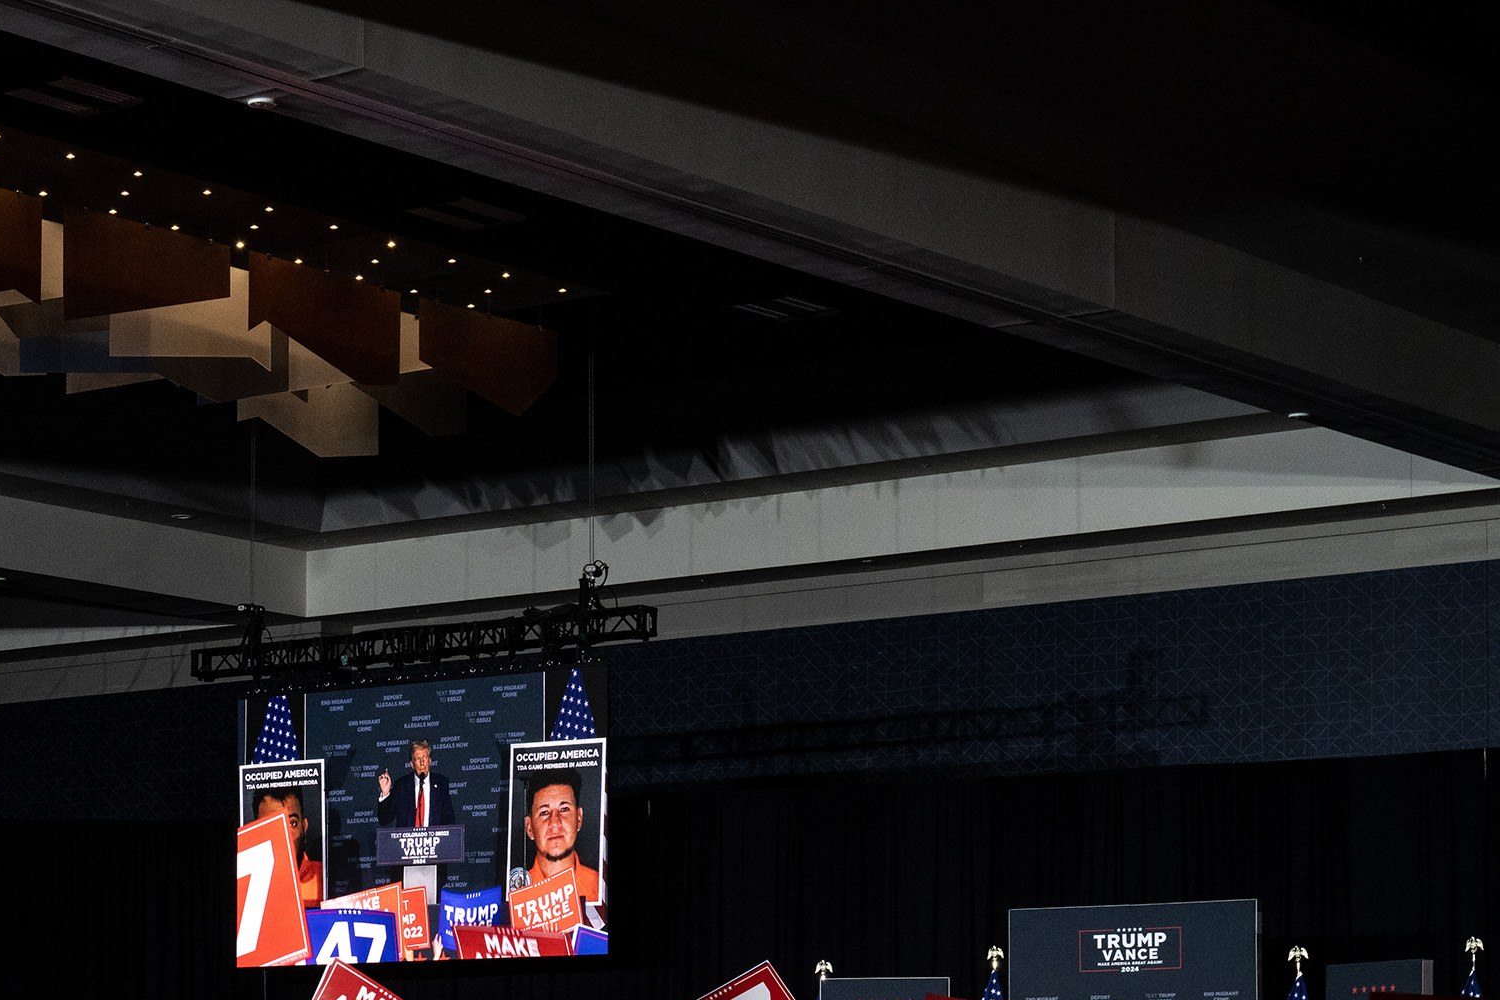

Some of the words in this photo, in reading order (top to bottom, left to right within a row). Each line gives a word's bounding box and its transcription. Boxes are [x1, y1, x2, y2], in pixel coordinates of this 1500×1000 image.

[516, 752, 558, 762] OCCUPIED
[560, 748, 600, 760] AMERICA
[544, 762, 568, 770] MEMBERS
[576, 760, 598, 768] AURORA
[245, 772, 282, 782] OCCUPIED
[284, 768, 318, 778] AMERICA
[399, 837, 440, 848] TRUMP
[404, 846, 436, 856] VANCE
[514, 884, 574, 918] TRUMP
[444, 904, 498, 922] TRUMP
[522, 902, 570, 926] VANCE
[316, 921, 387, 965] 47
[484, 933, 540, 956] MAKE
[1093, 932, 1167, 950] TRUMP
[1102, 948, 1158, 962] VANCE
